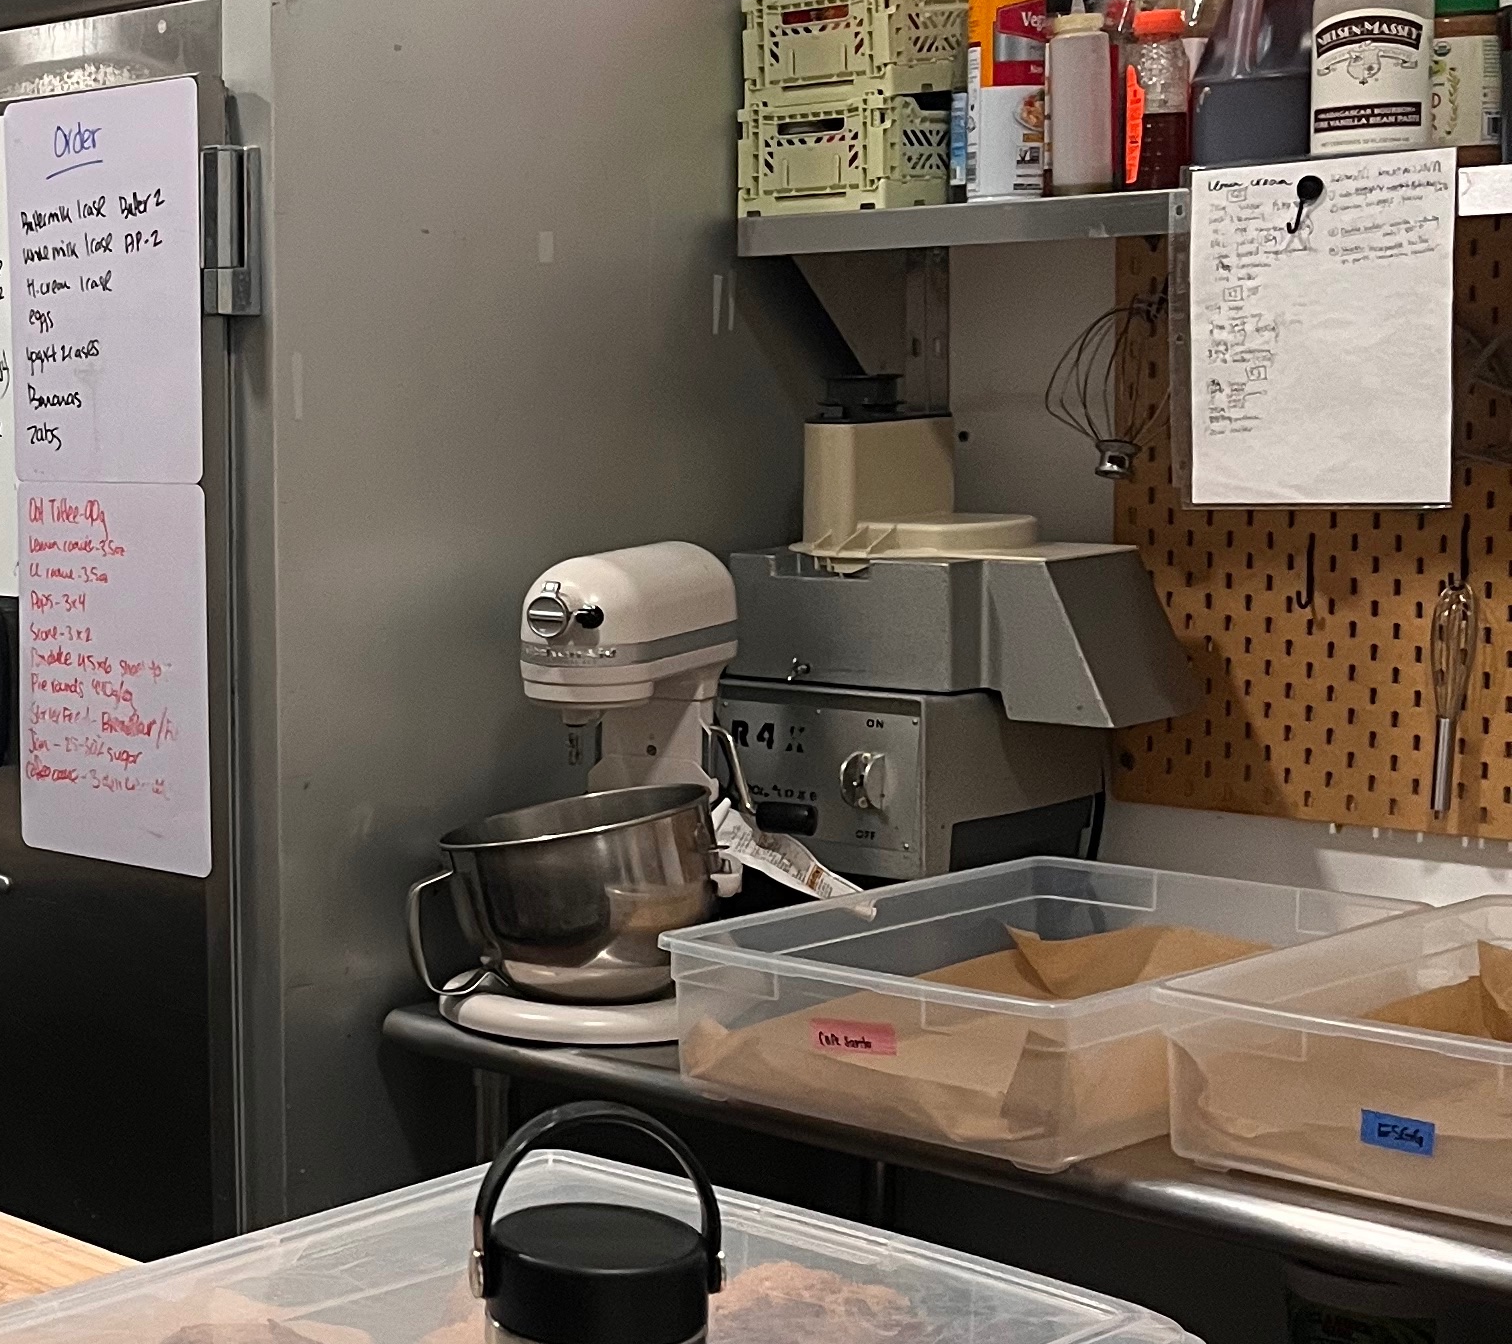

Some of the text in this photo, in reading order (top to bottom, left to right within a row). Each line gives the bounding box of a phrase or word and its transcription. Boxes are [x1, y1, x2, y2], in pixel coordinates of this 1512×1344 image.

[1021, 10, 1047, 32] Veg
[54, 121, 102, 157] Order
[29, 309, 54, 333] eggs
[27, 382, 82, 411] Bananas
[865, 717, 885, 729] ON
[855, 829, 876, 841] OFF
